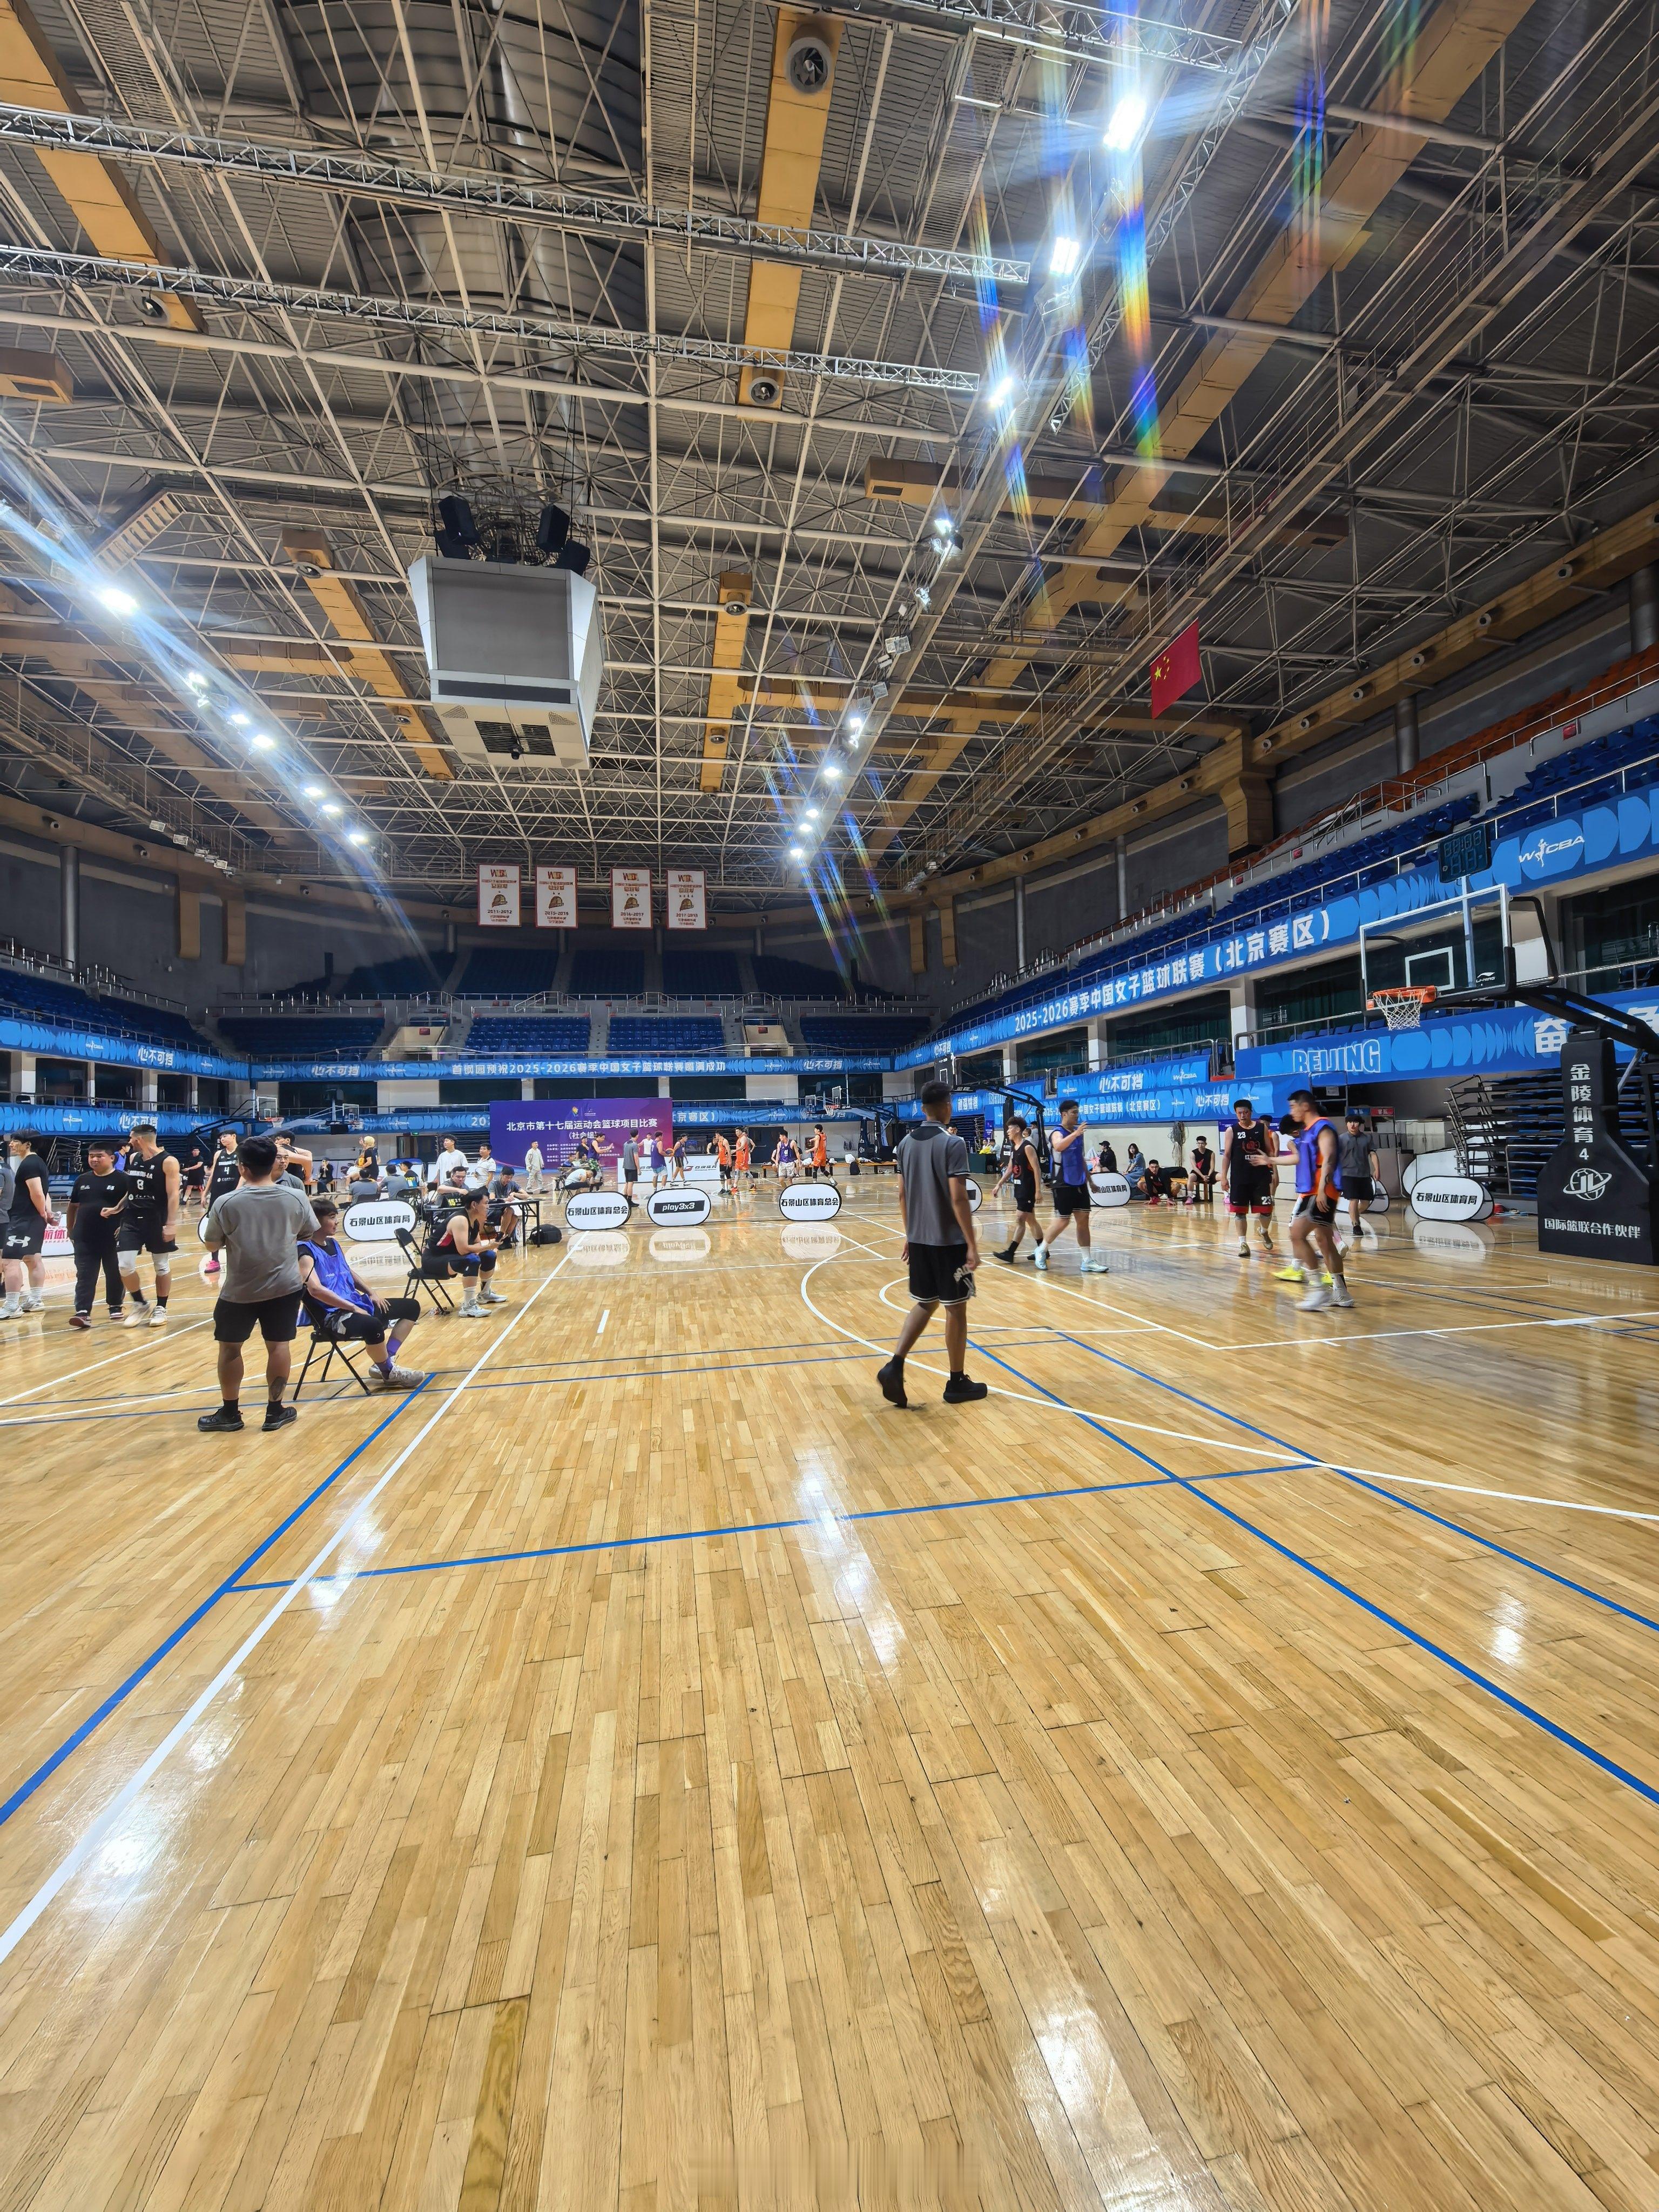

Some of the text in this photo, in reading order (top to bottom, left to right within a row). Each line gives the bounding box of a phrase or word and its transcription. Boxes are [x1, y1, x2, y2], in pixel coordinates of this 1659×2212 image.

[138, 1047, 174, 1066] 心不可挡
[1099, 1073, 1144, 1094] 心不可挡
[1195, 1094, 1230, 1107] 心不可挡
[1570, 1063, 1593, 1143] 金陵体育
[506, 1118, 658, 1131] 北京市第十七届运动会篮球项目比赛
[1579, 1148, 1589, 1160] 4
[224, 1166, 230, 1175] 4
[137, 1179, 144, 1190] 8
[781, 1197, 839, 1206] 石景山区体育总会
[1416, 1192, 1478, 1205] 石景山区体育局
[567, 1206, 628, 1216] 石景山区体育总会
[662, 1202, 696, 1212] play3x3
[349, 1215, 410, 1226] 石景山区体育局
[1544, 1218, 1641, 1239] 国际篮联合作伙伴
